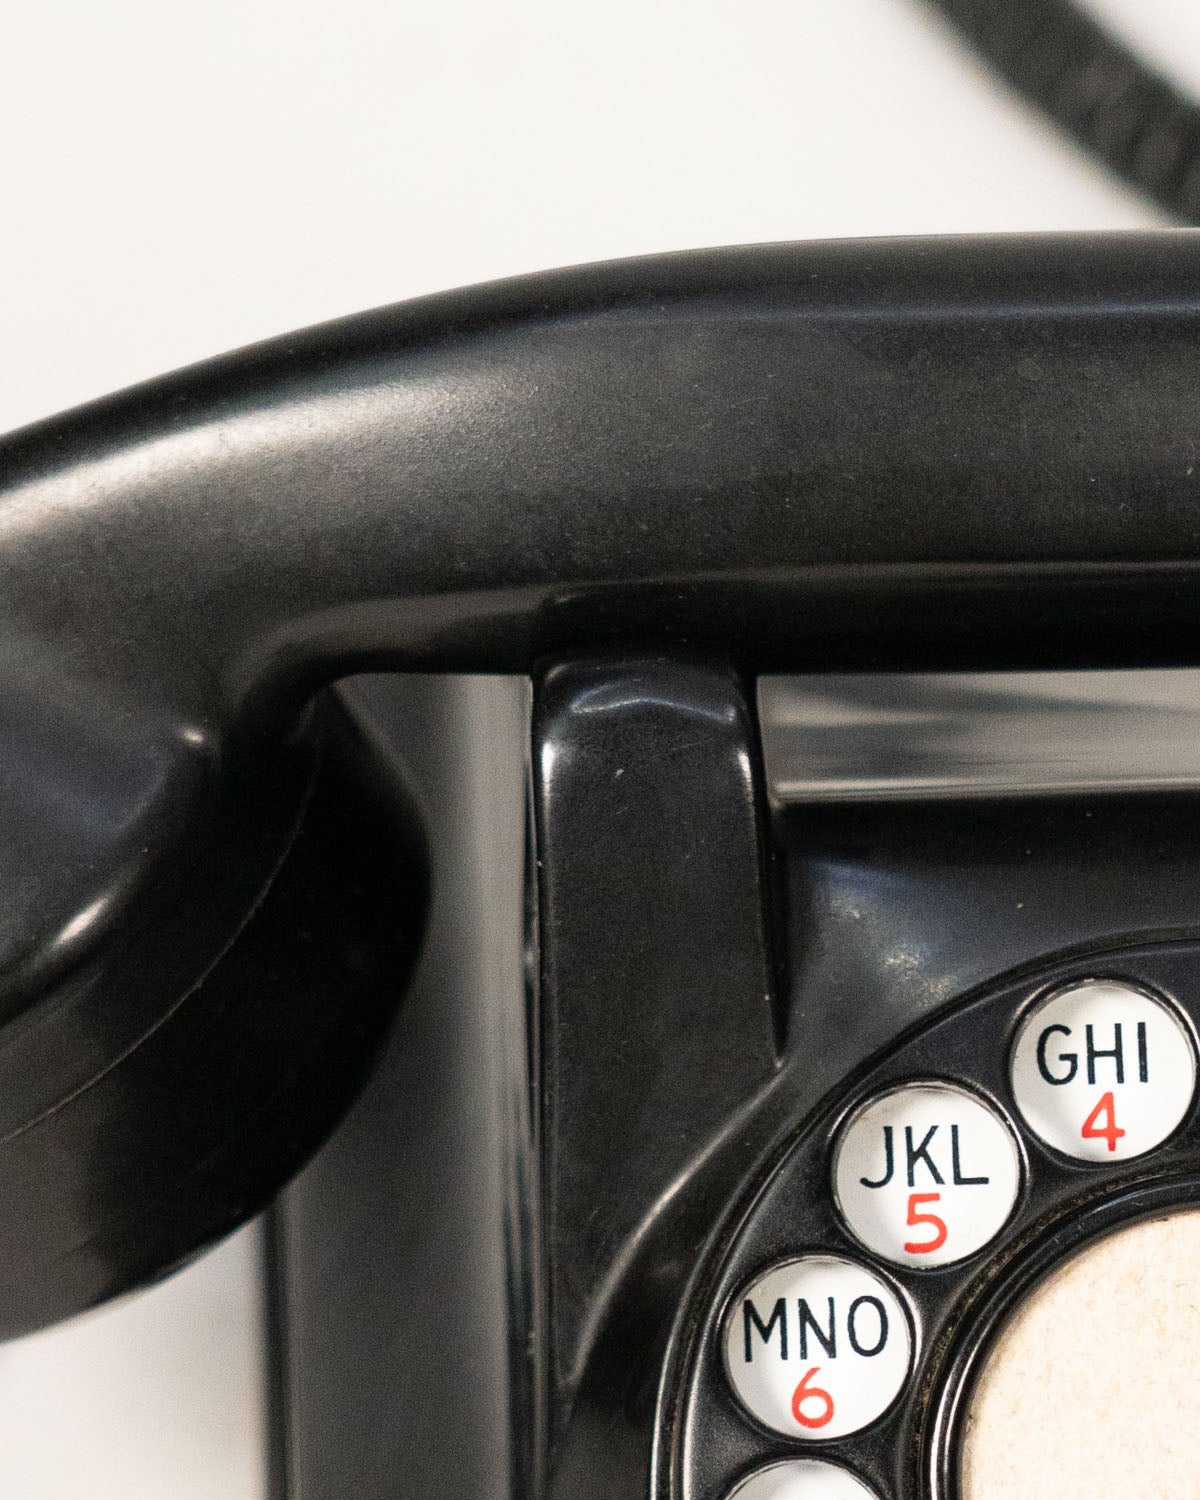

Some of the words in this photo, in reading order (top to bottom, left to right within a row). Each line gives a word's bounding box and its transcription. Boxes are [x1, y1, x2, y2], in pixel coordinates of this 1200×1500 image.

[1035, 1021, 1149, 1086] GHI
[1080, 1091, 1126, 1152] 4
[859, 1124, 990, 1189] JKL
[903, 1192, 948, 1255] 5
[742, 1294, 890, 1363] MNO
[790, 1366, 835, 1430] 6
